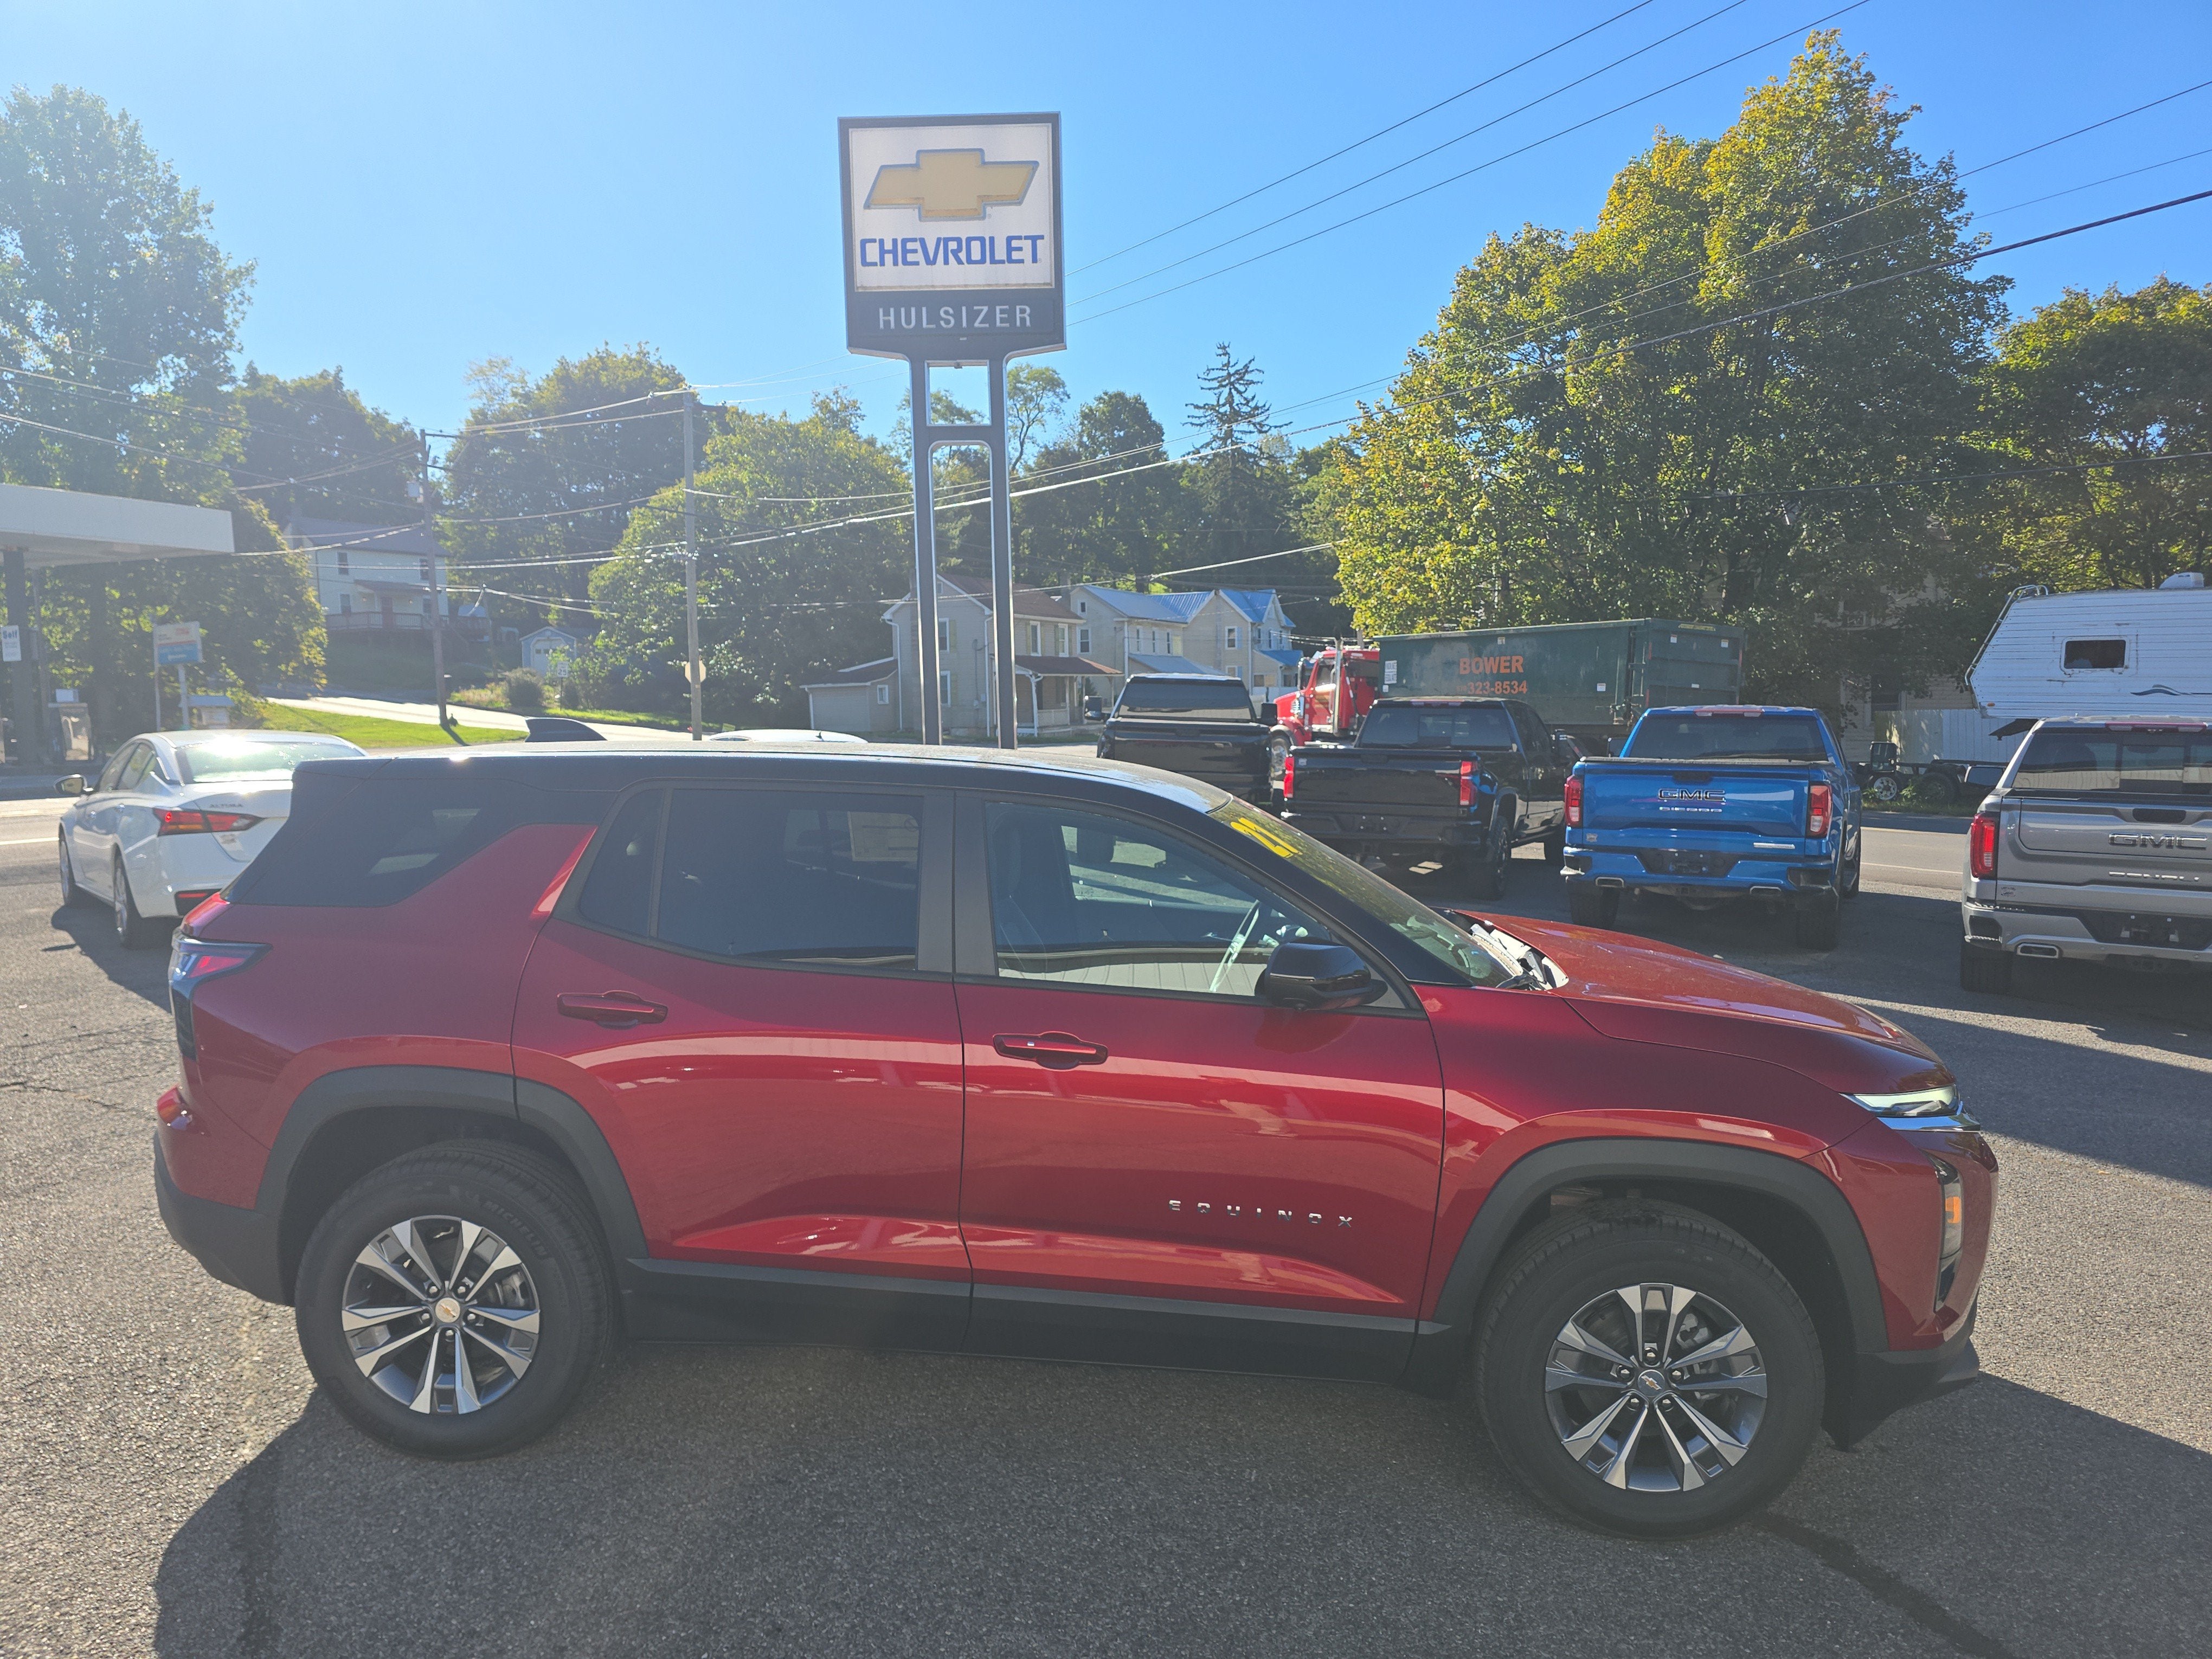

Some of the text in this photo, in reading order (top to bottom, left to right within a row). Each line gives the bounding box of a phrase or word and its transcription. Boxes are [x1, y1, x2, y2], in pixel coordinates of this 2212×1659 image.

[860, 234, 1044, 267] CHEVROLET
[879, 305, 1031, 329] HULSIZER
[1459, 655, 1524, 674] BOWER
[1467, 680, 1528, 695] 323-8534
[1658, 788, 1726, 801] GMC
[2108, 832, 2208, 851] GMC
[1168, 1199, 1353, 1228] EQUINOX
[484, 1200, 548, 1257] MICHELIN
